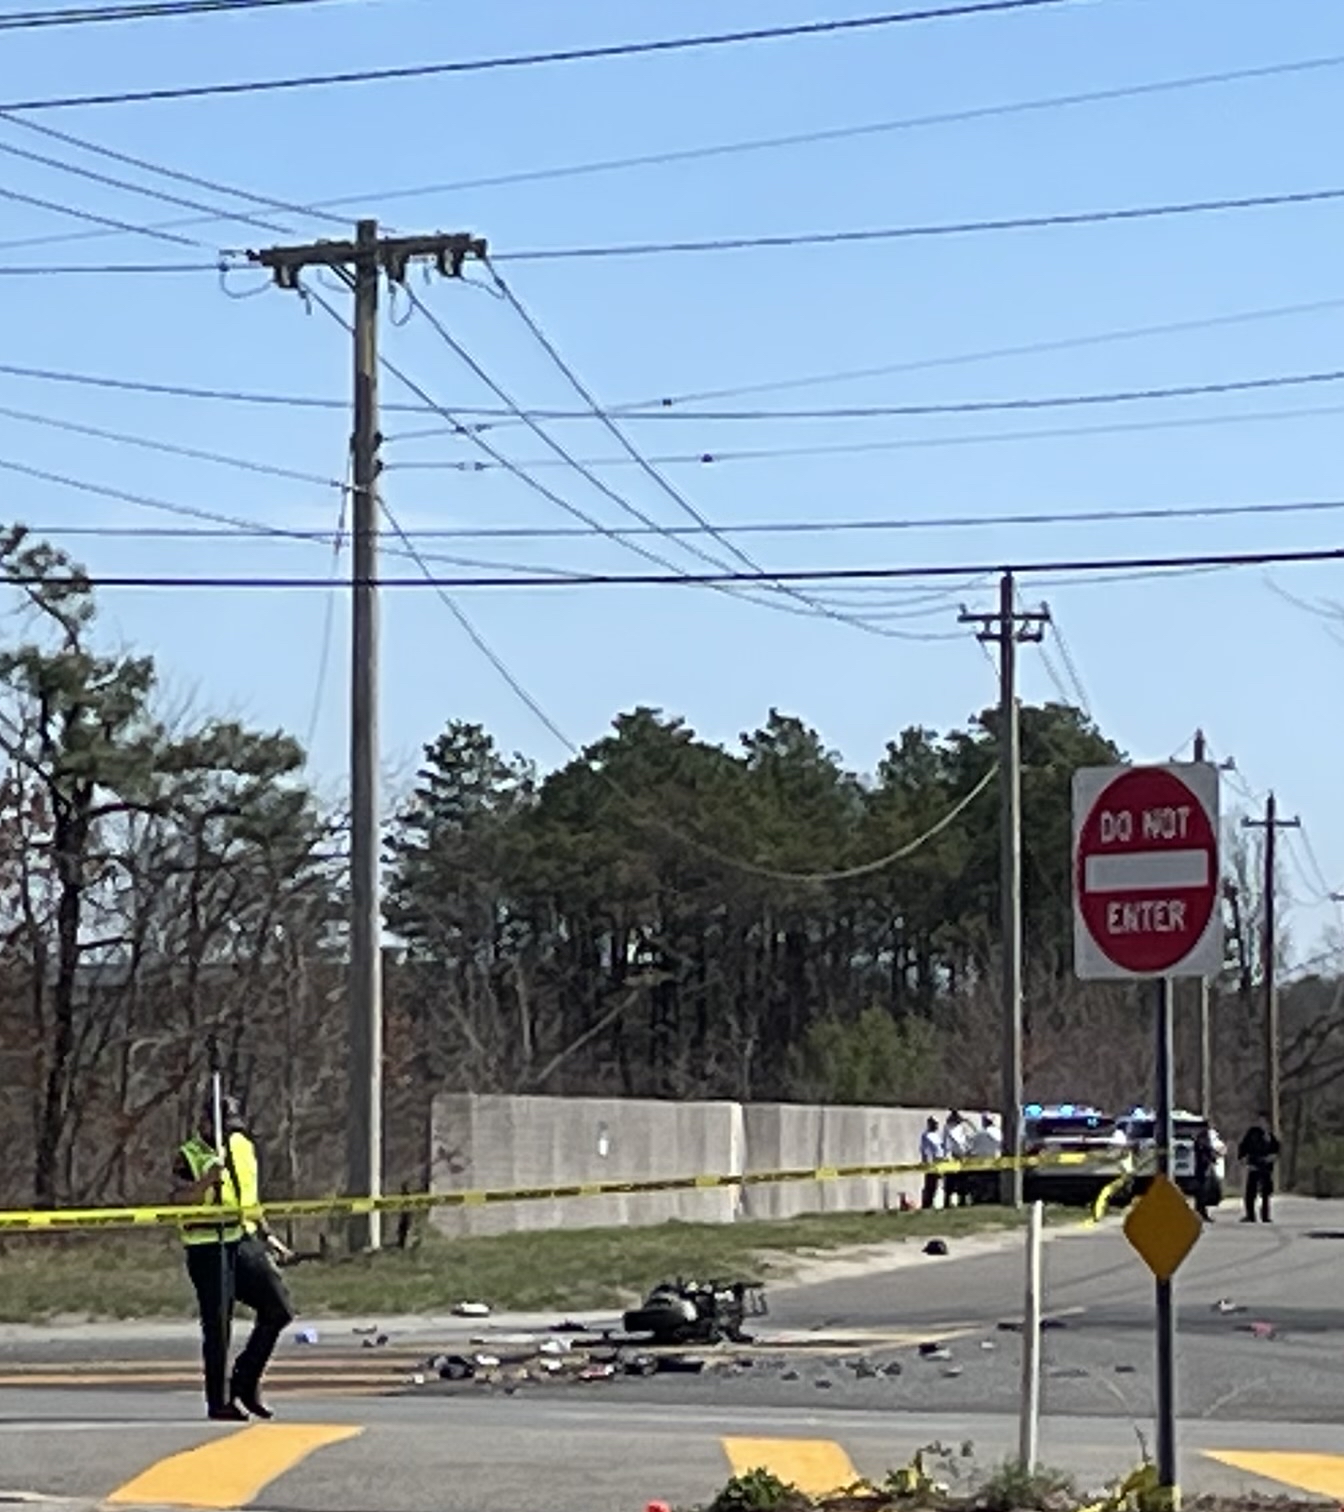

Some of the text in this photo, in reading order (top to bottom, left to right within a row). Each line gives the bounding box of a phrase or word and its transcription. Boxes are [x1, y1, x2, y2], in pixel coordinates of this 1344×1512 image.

[1100, 805, 1191, 843] DO NOT
[1107, 899, 1187, 935] ENTER
